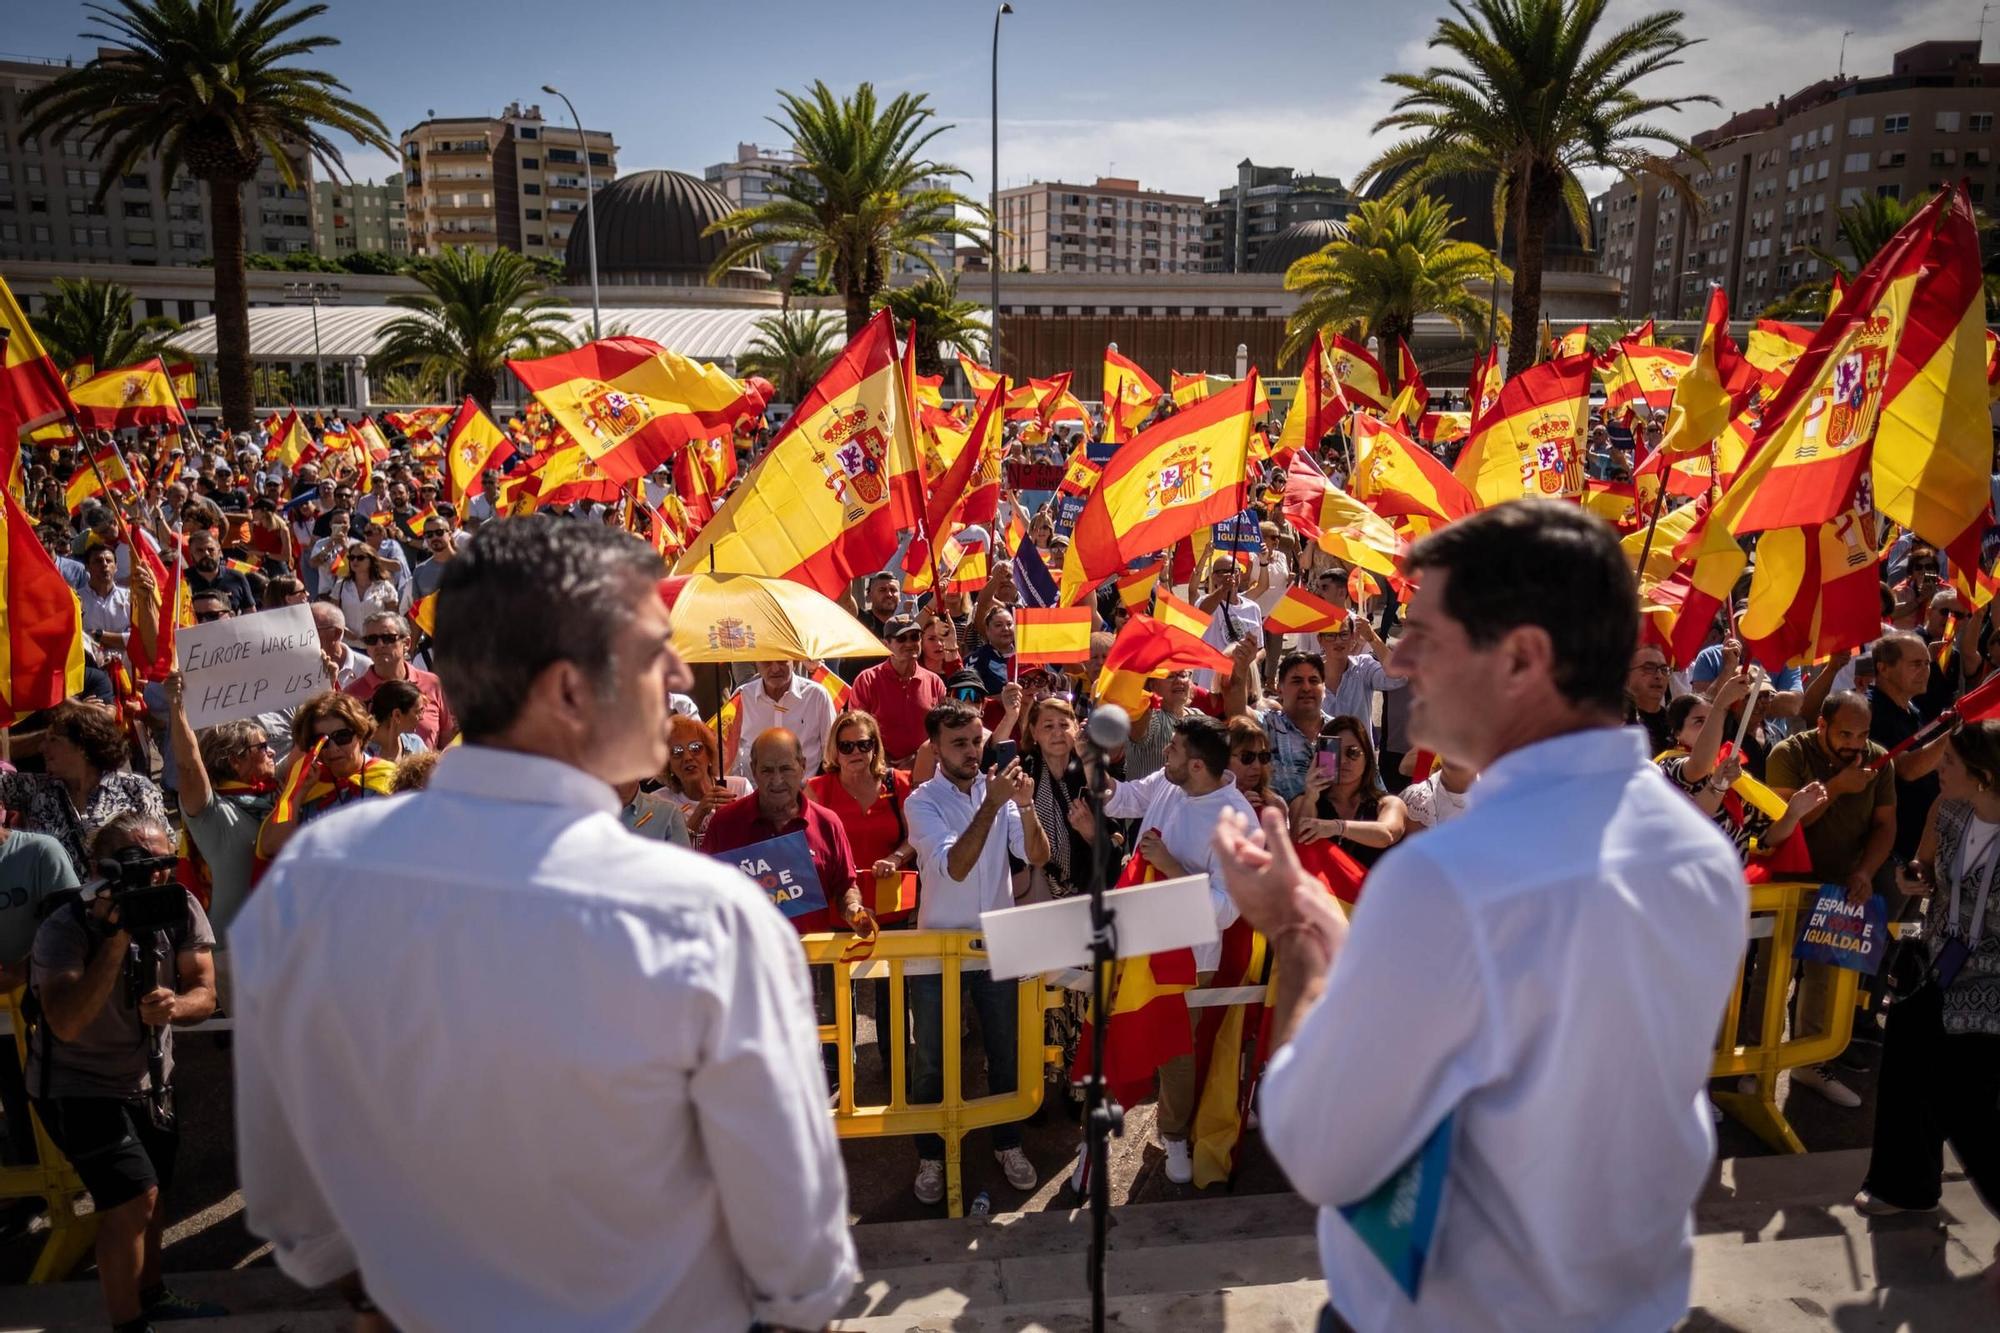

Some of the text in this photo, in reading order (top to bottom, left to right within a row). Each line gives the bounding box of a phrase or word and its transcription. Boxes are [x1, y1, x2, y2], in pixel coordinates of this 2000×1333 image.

[1062, 511, 1074, 519] EN
[1218, 523, 1230, 532] EN
[185, 629, 315, 673] EUROPE WAKE UP
[201, 678, 269, 713] HELP
[779, 869, 793, 885] E
[1809, 913, 1827, 928] EN
[1862, 924, 1873, 938] E
[1803, 928, 1872, 954] IGUALDAD
